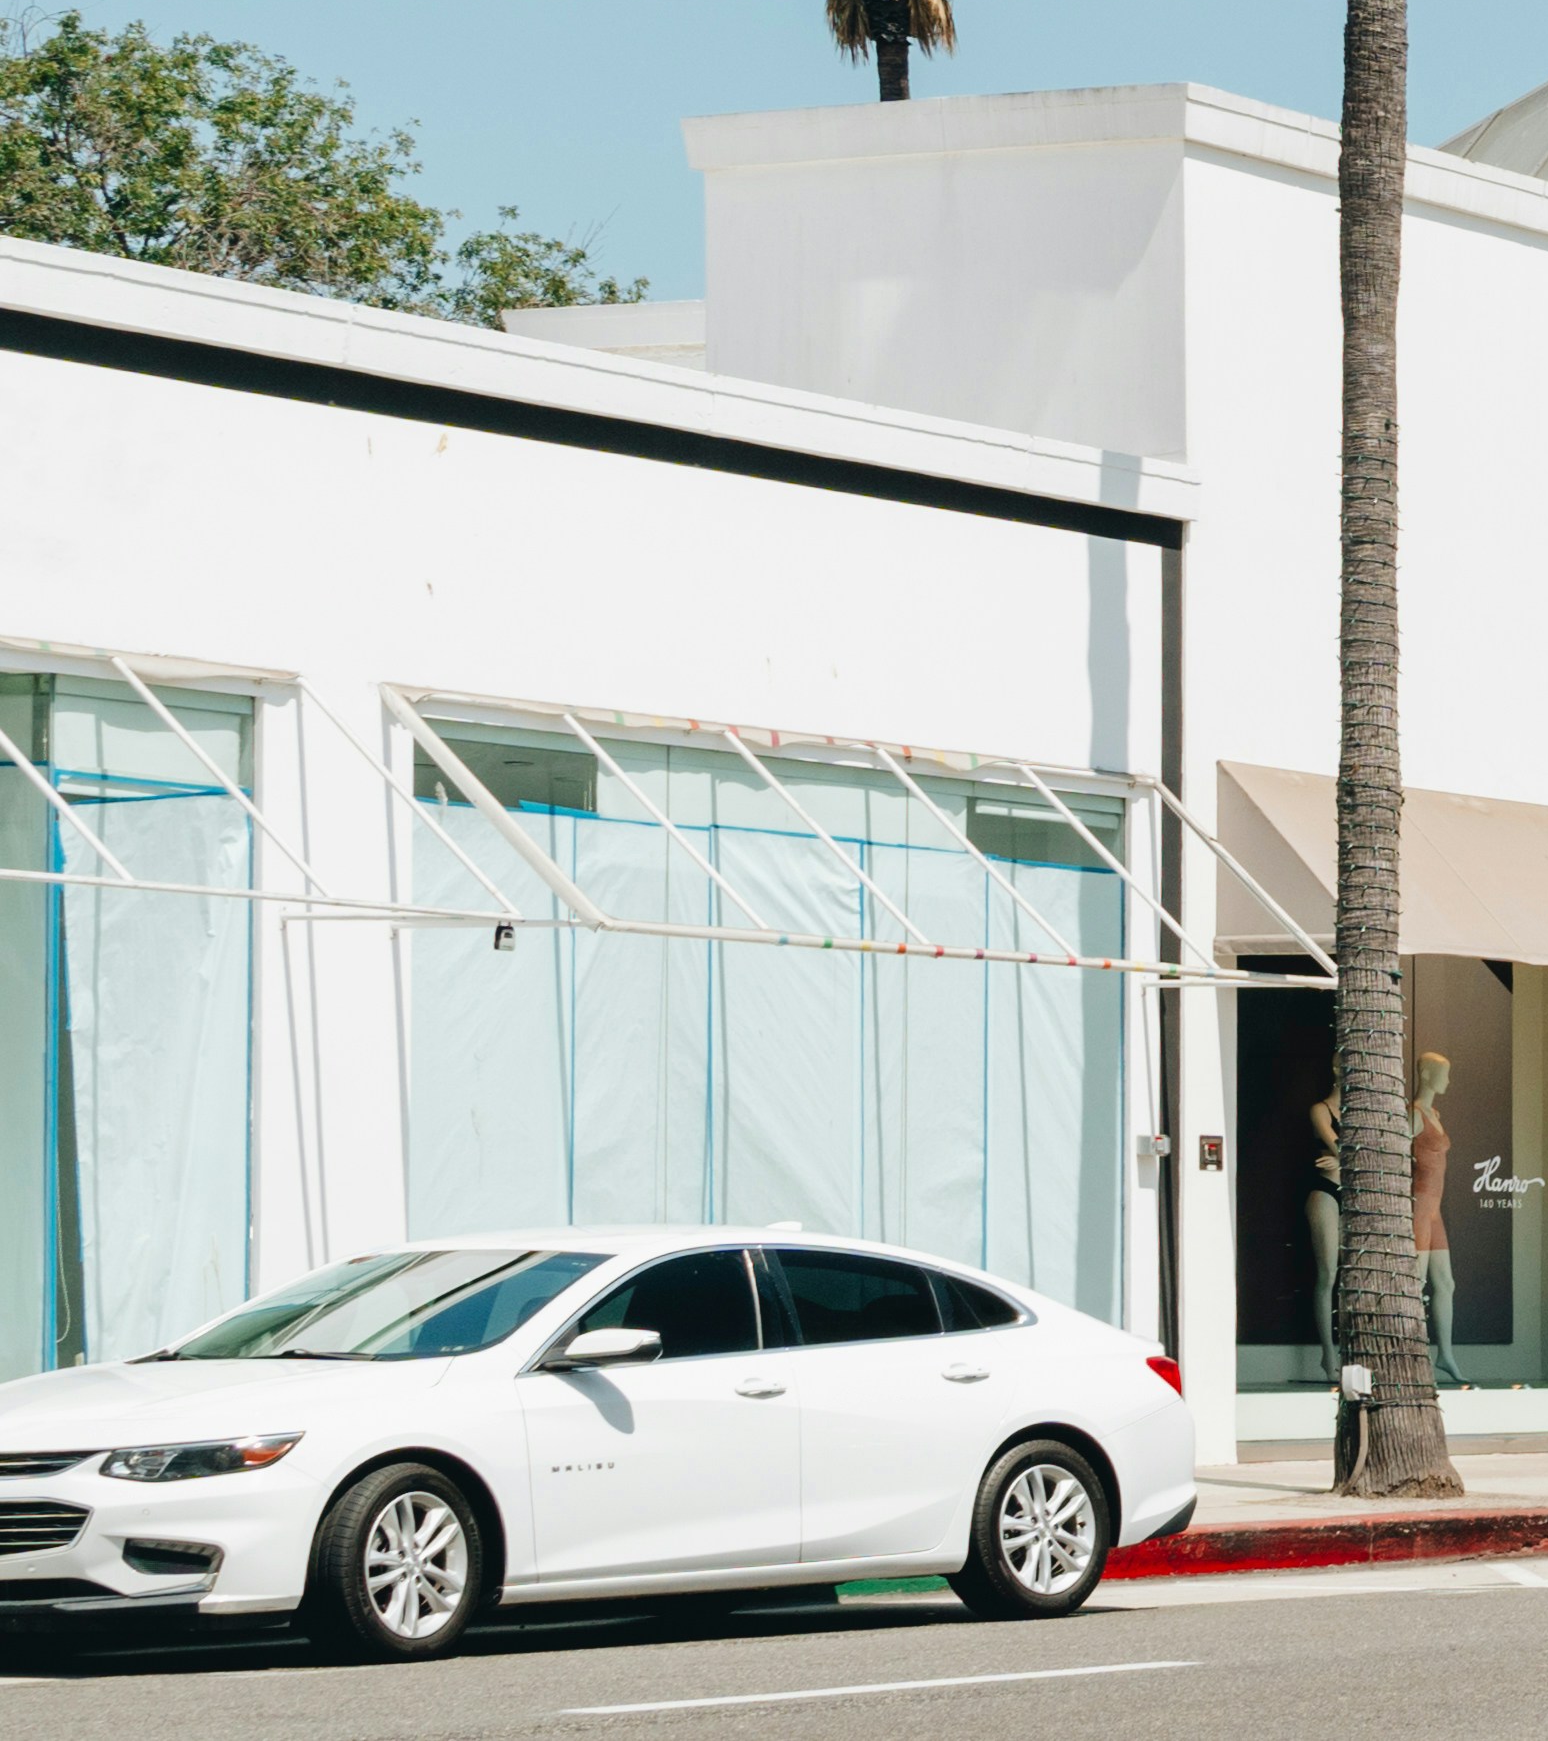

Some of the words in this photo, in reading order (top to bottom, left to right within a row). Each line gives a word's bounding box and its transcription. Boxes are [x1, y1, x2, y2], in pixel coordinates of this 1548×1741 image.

[1473, 1155, 1545, 1193] Hanro
[1480, 1199, 1494, 1209] 140
[1497, 1199, 1522, 1209] YEARS
[551, 1462, 615, 1473] MALIBU
